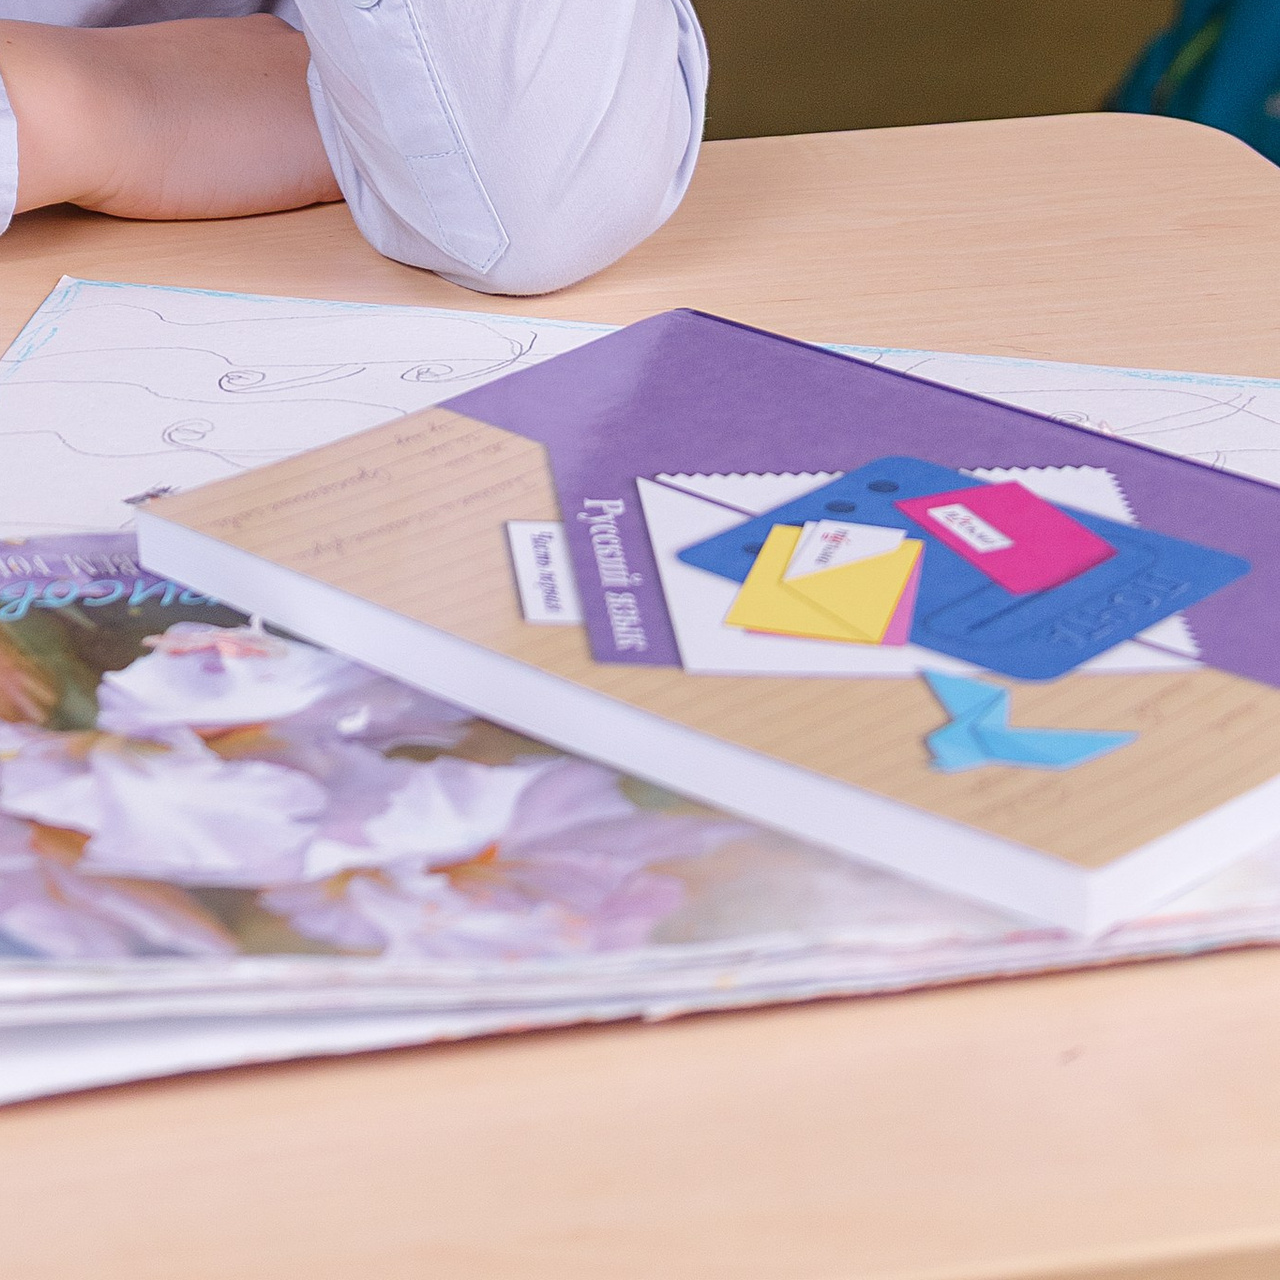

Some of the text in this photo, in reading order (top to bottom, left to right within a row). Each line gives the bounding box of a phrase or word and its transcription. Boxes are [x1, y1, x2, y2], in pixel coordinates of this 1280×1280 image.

[530, 531, 561, 613] Часть первая
[576, 497, 647, 651] Русский язык
